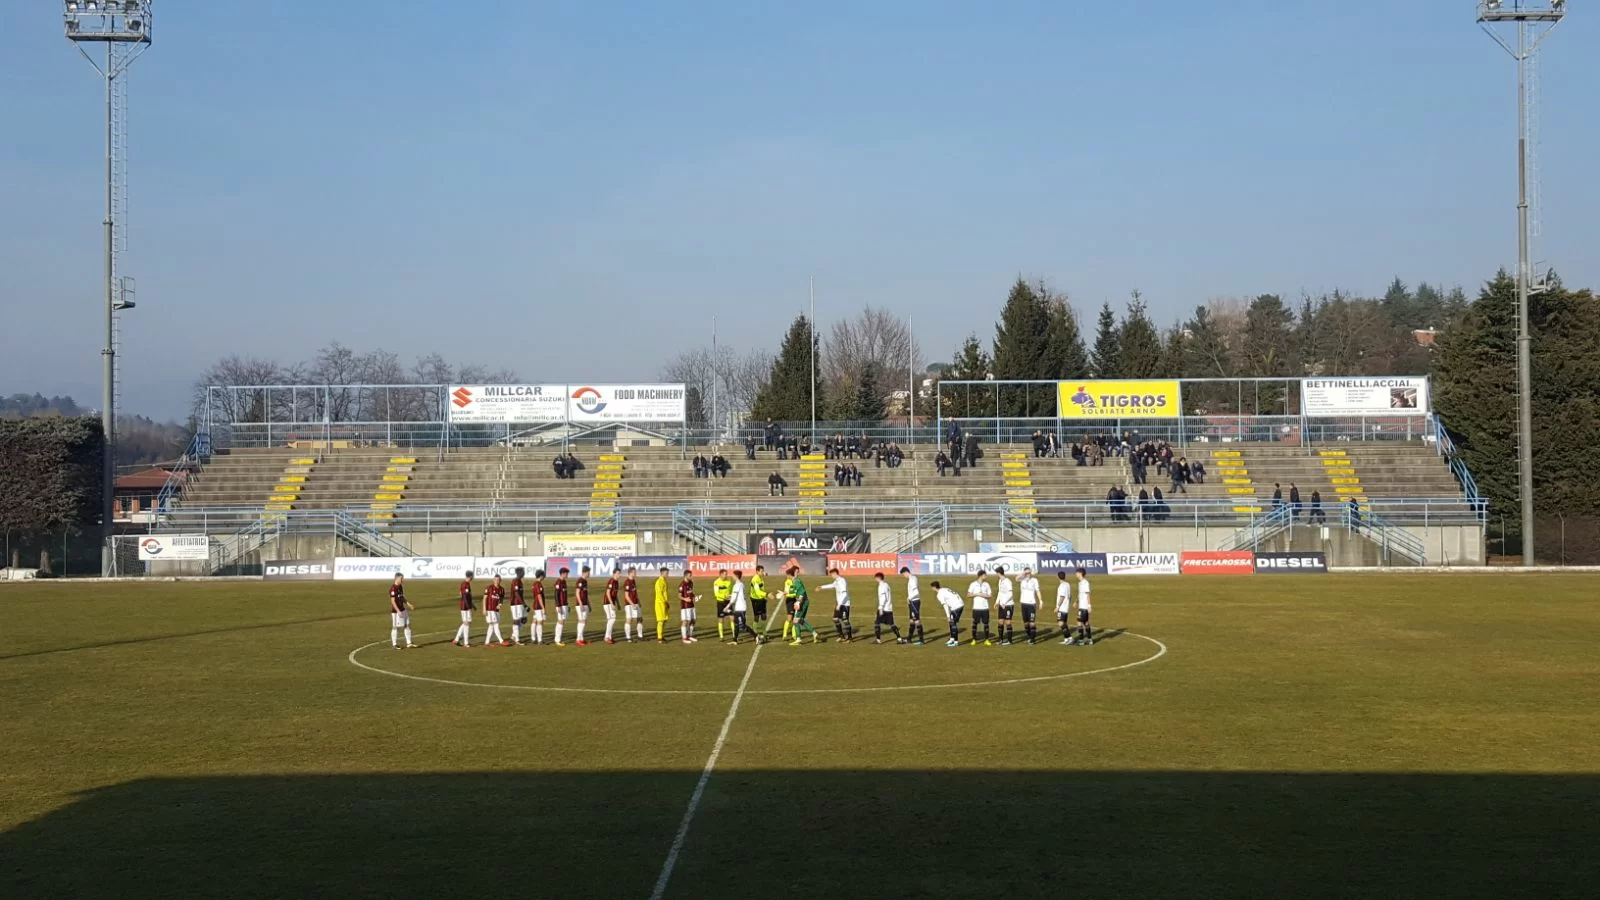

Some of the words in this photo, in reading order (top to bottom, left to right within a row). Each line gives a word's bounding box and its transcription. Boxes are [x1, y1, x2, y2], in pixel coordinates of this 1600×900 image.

[485, 386, 543, 396] MILLCAR
[614, 389, 635, 400] FOOD
[637, 389, 684, 399] MACHINERY
[1100, 395, 1166, 407] TIGROS
[777, 538, 818, 549] MILAN
[368, 564, 401, 572] TIRES
[435, 563, 461, 571] Group
[573, 557, 616, 576] TIM
[656, 561, 683, 570] MEN
[689, 561, 708, 572] Fly
[709, 560, 756, 570] Emirates
[829, 559, 847, 570] Fly
[849, 559, 896, 569] Emirates
[924, 555, 966, 574] TIM
[968, 563, 1010, 572] BANCO
[1041, 560, 1075, 568] NIVEA
[1076, 559, 1103, 568] MEN
[1183, 559, 1251, 567] FRECCIAROSSA
[1256, 557, 1324, 568] DIESEL
[266, 564, 331, 575] DIESEL
